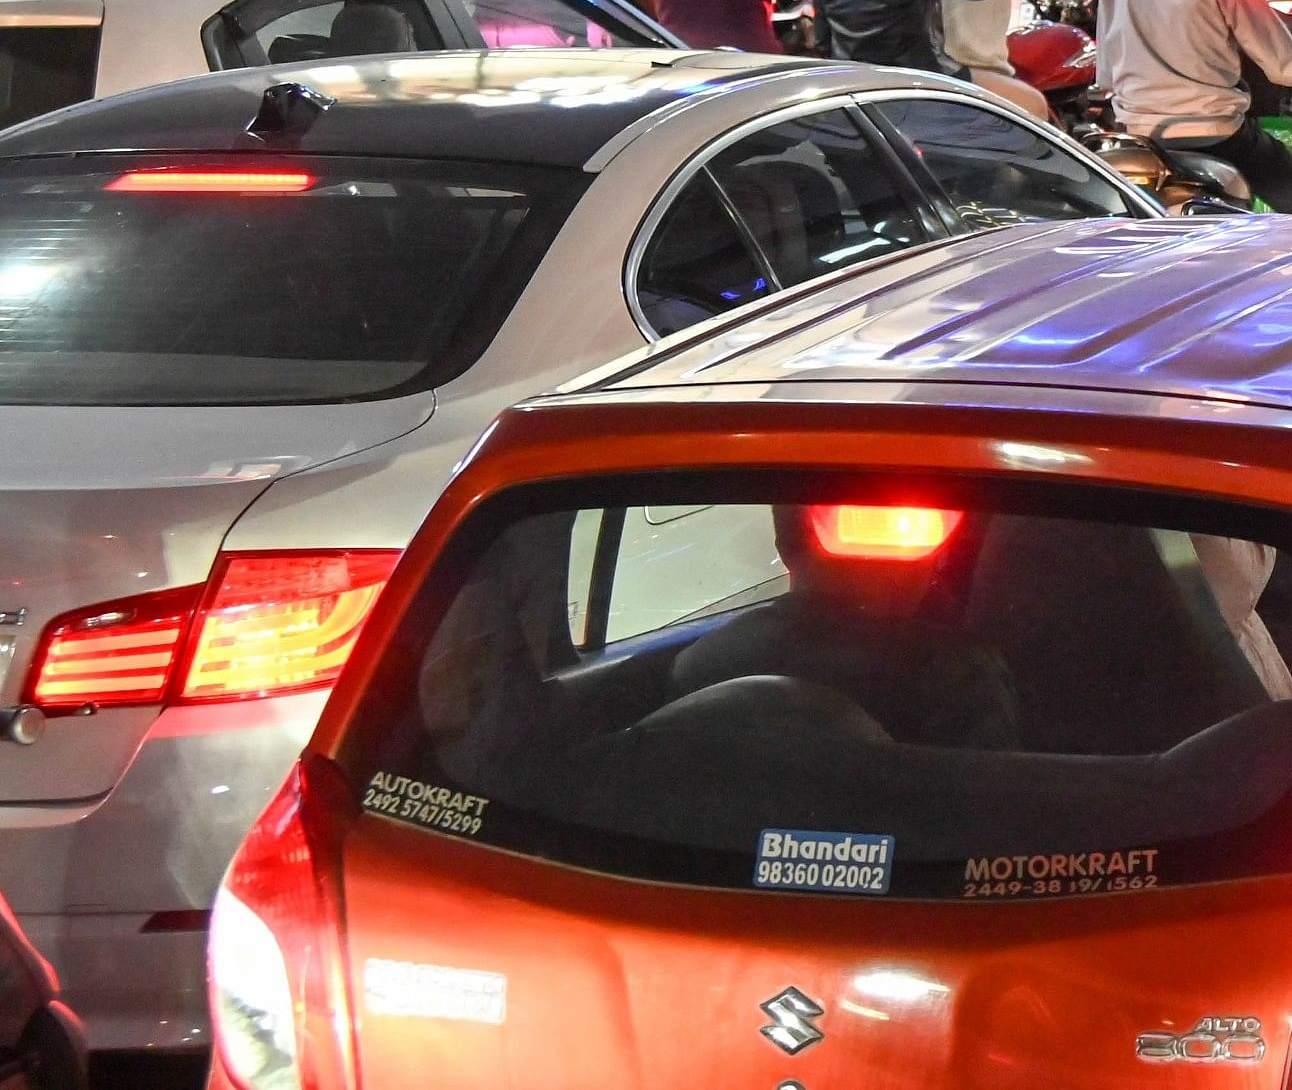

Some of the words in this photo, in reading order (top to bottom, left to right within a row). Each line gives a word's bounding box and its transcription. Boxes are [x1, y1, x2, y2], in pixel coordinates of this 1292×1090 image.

[369, 770, 490, 817] AUTOKRAFT
[363, 788, 401, 814] 2492
[400, 798, 482, 835] 5747/5299
[761, 832, 889, 864] Bhandari
[757, 860, 820, 887] 98360
[821, 863, 884, 890] 02002
[964, 848, 1159, 881] MOTORKRAFT
[1198, 1017, 1261, 1031] ALTO
[1135, 1031, 1266, 1063] 800
